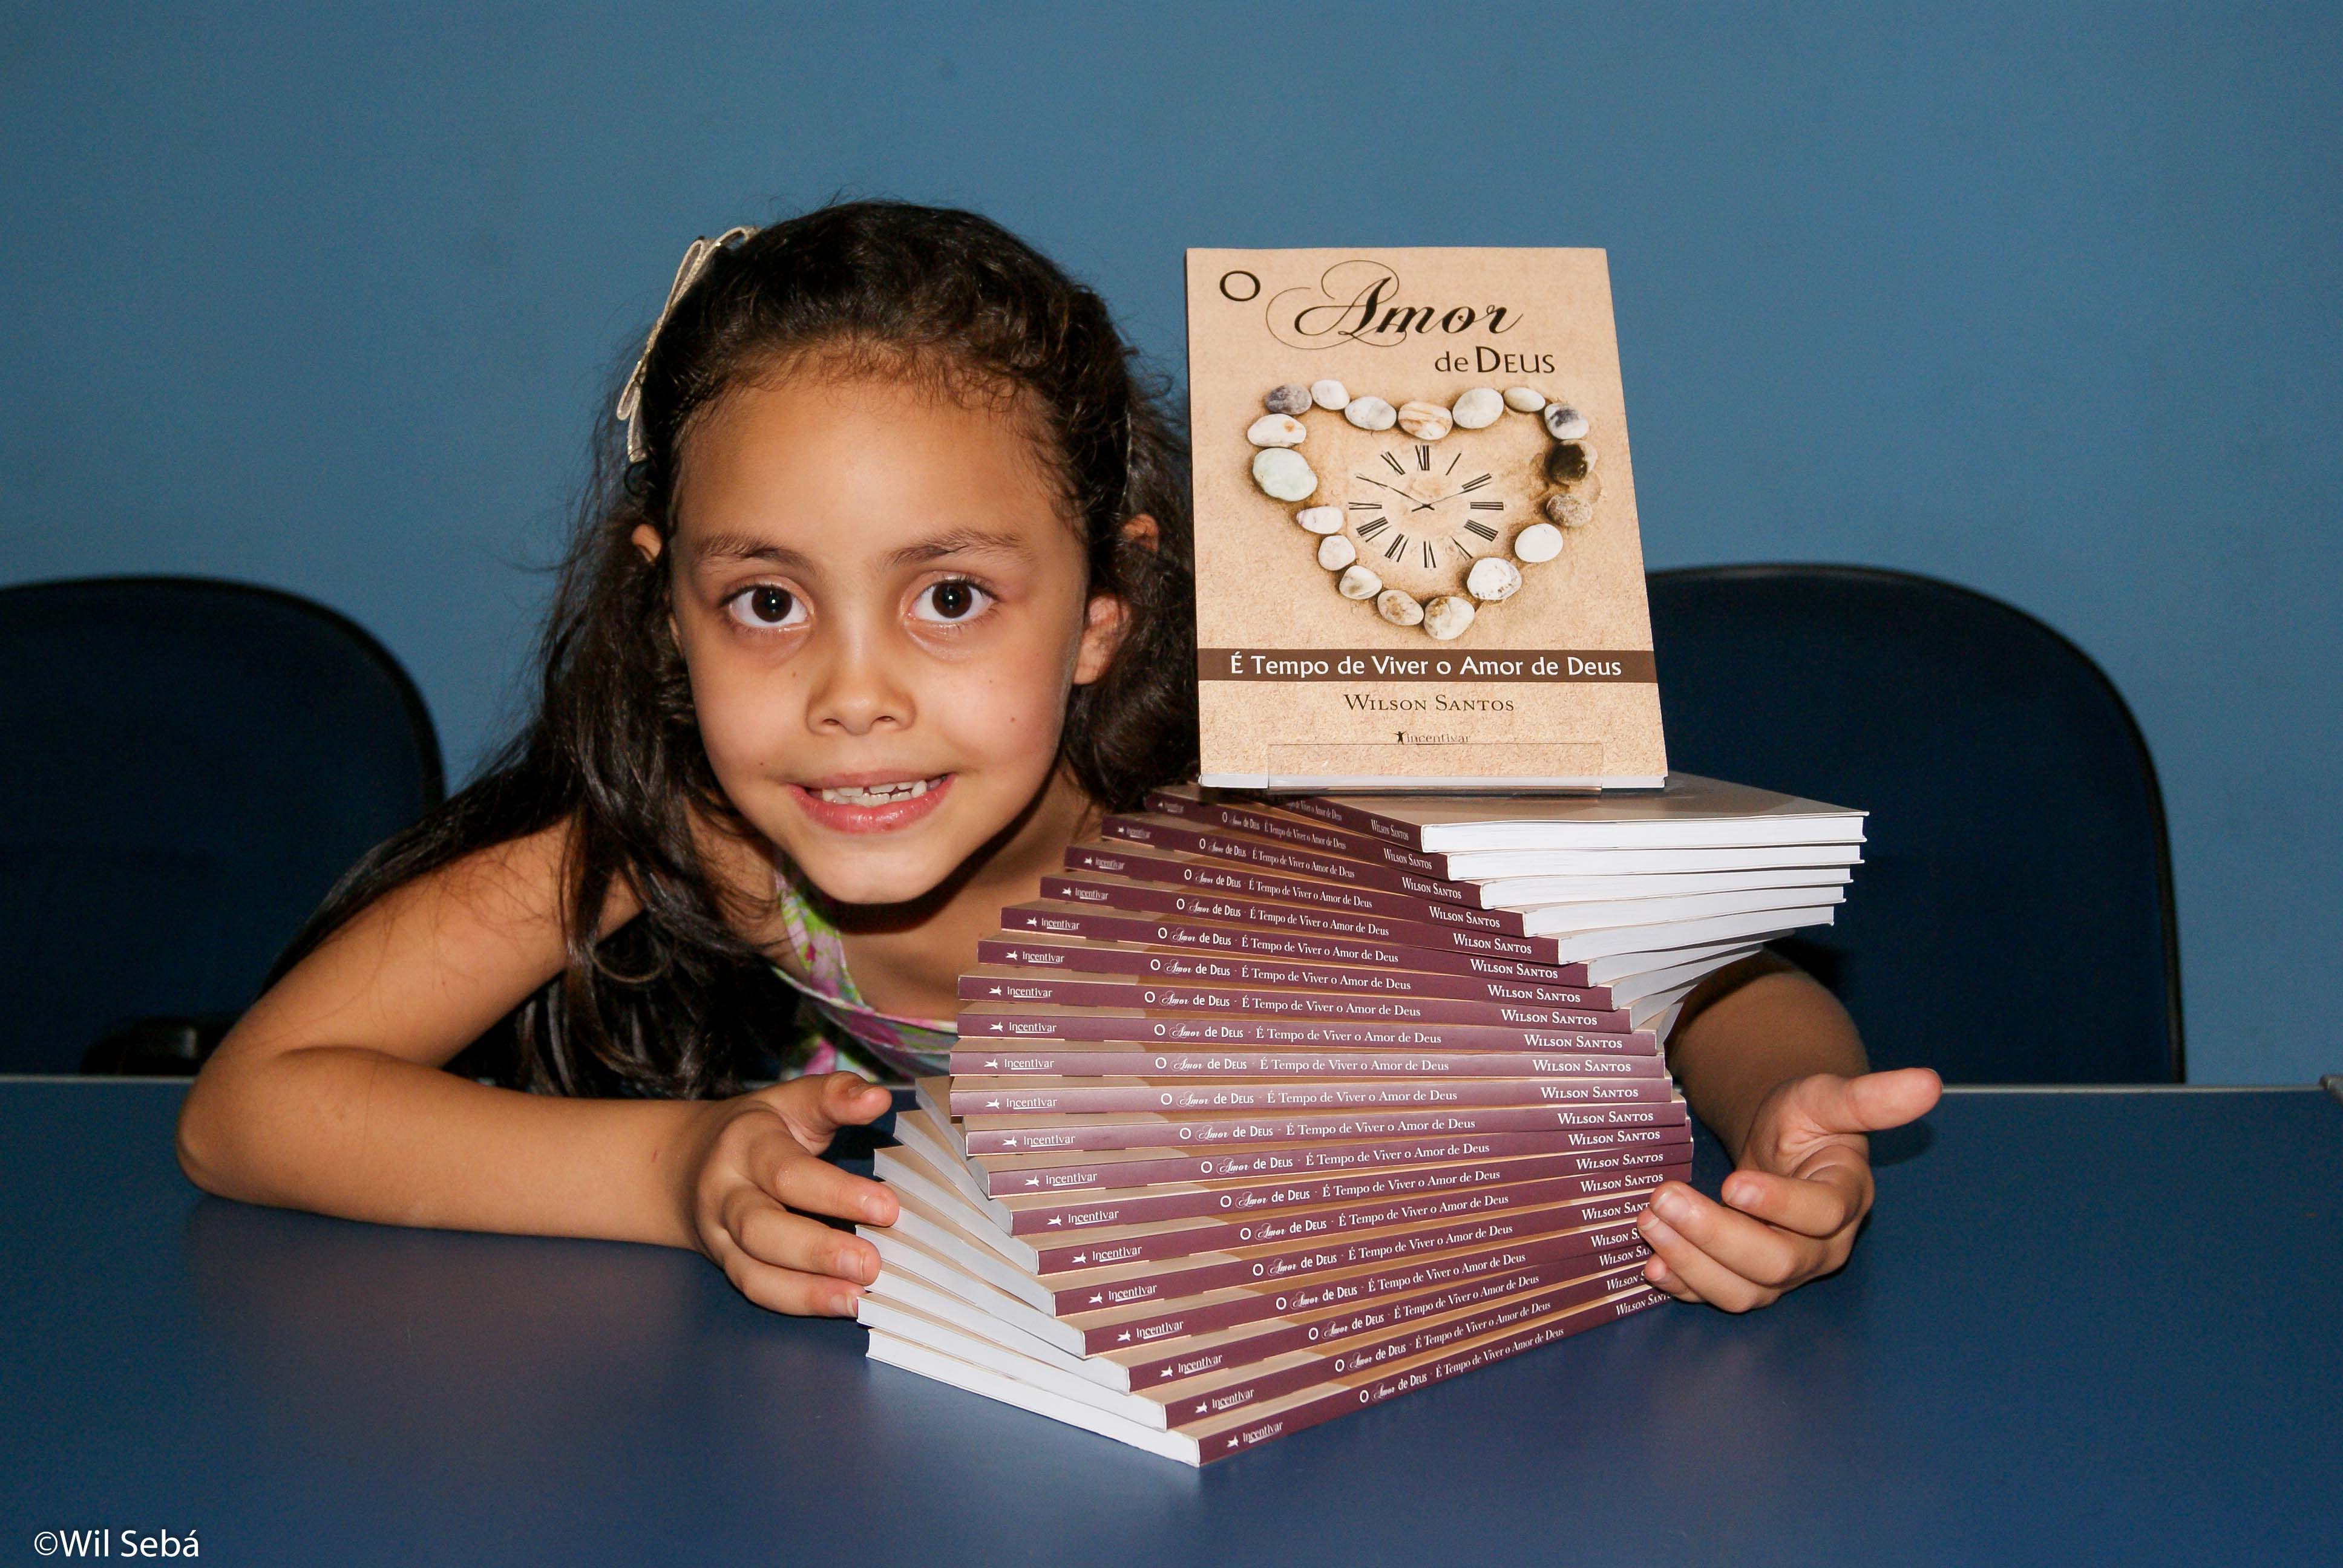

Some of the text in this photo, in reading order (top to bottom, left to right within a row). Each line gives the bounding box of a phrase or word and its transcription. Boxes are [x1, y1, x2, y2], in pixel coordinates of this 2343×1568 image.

[1219, 260, 1524, 350] O Amor
[1435, 345, 1556, 374] de DEUS
[1230, 651, 1622, 678] É Tempo de Viver o Amor de Deus
[1343, 694, 1515, 711] WILSON SANTOS
[1216, 875, 1225, 886] de
[1249, 878, 1254, 890] É
[1256, 881, 1280, 896] Tempo
[1282, 885, 1291, 895] de
[1293, 886, 1311, 898] Viver
[1320, 891, 1342, 903] Amor
[1343, 895, 1352, 905] de
[1353, 896, 1372, 907] Deus
[1429, 906, 1501, 928] WILSON SANTOS
[1158, 927, 1168, 939] O
[1171, 930, 1196, 941] Amor
[1199, 932, 1210, 944] de
[1242, 935, 1249, 947] É
[1251, 938, 1282, 953] Tempo
[1284, 941, 1296, 952] de
[1297, 942, 1322, 955] Viver
[1332, 946, 1360, 959] Amor
[1362, 949, 1372, 959] de
[1375, 950, 1399, 962] Deus
[1470, 959, 1558, 979] WILSON SANTOS
[1145, 991, 1156, 1003] O
[1159, 993, 1190, 1005] Amor
[1193, 994, 1205, 1005] de
[1242, 995, 1250, 1008] É
[1252, 998, 1288, 1012] Tempo
[1291, 1001, 1303, 1010] de
[1306, 1001, 1334, 1012] Viver
[1346, 1003, 1377, 1014] Amor
[1379, 1004, 1391, 1014] de
[1394, 1005, 1421, 1016] Deus
[1501, 1009, 1598, 1025] WILSON SANTOS
[1155, 1057, 1167, 1069] O
[1171, 1058, 1204, 1071] Amor
[1208, 1058, 1221, 1069] de
[1260, 1057, 1269, 1070] É
[1271, 1059, 1309, 1073] Tempo
[1312, 1059, 1326, 1070] de
[1328, 1059, 1358, 1070] Viver
[1371, 1060, 1403, 1070] Amor
[1406, 1060, 1418, 1070] de
[1421, 1059, 1449, 1070] Deus
[1532, 1059, 1632, 1071] WILSON SANTOS
[1557, 1111, 1654, 1124] WILSON SANTOS
[1179, 1127, 1191, 1139] O
[1195, 1125, 1230, 1140] Amor
[1233, 1126, 1247, 1137] de
[1286, 1123, 1296, 1135] É
[1297, 1125, 1336, 1137] Tempo
[1339, 1123, 1352, 1133] de
[1355, 1122, 1385, 1132] Viver
[1398, 1121, 1429, 1131] Amor
[1432, 1119, 1445, 1129] de
[1448, 1118, 1476, 1129] Deus
[1576, 1154, 1663, 1170] WILSON SANTOS
[1221, 1195, 1232, 1207] O
[1235, 1191, 1268, 1207] Amor
[1271, 1191, 1285, 1203] de
[1323, 1184, 1331, 1197] É
[1333, 1185, 1370, 1197] Tempo
[1373, 1181, 1385, 1192] de
[1388, 1179, 1416, 1190] Viver
[1427, 1176, 1458, 1186] Amor
[1460, 1172, 1472, 1183] de
[1475, 1171, 1501, 1181] Deus
[1582, 1201, 1651, 1220] WILSON SANT
[1253, 1263, 1264, 1276] O
[1267, 1259, 1298, 1274] Amor
[1301, 1256, 1313, 1268] de
[1349, 1247, 1357, 1260] É
[1358, 1247, 1393, 1258] Tempo
[1395, 1241, 1407, 1252] de
[1409, 1238, 1435, 1249] Viver
[1446, 1233, 1473, 1244] Amor
[1475, 1228, 1487, 1238] de
[1489, 1226, 1513, 1236] Deus
[1616, 1293, 1670, 1315] WILSON SANT
[1360, 1390, 1369, 1403] O
[1398, 1379, 1409, 1391] de
[1436, 1364, 1442, 1377] É
[1444, 1361, 1470, 1374] Tempo
[1472, 1354, 1482, 1365] de
[1483, 1349, 1504, 1361] Viver
[1513, 1339, 1533, 1350] Amor
[1534, 1333, 1543, 1344] de
[1545, 1329, 1564, 1341] Deus
